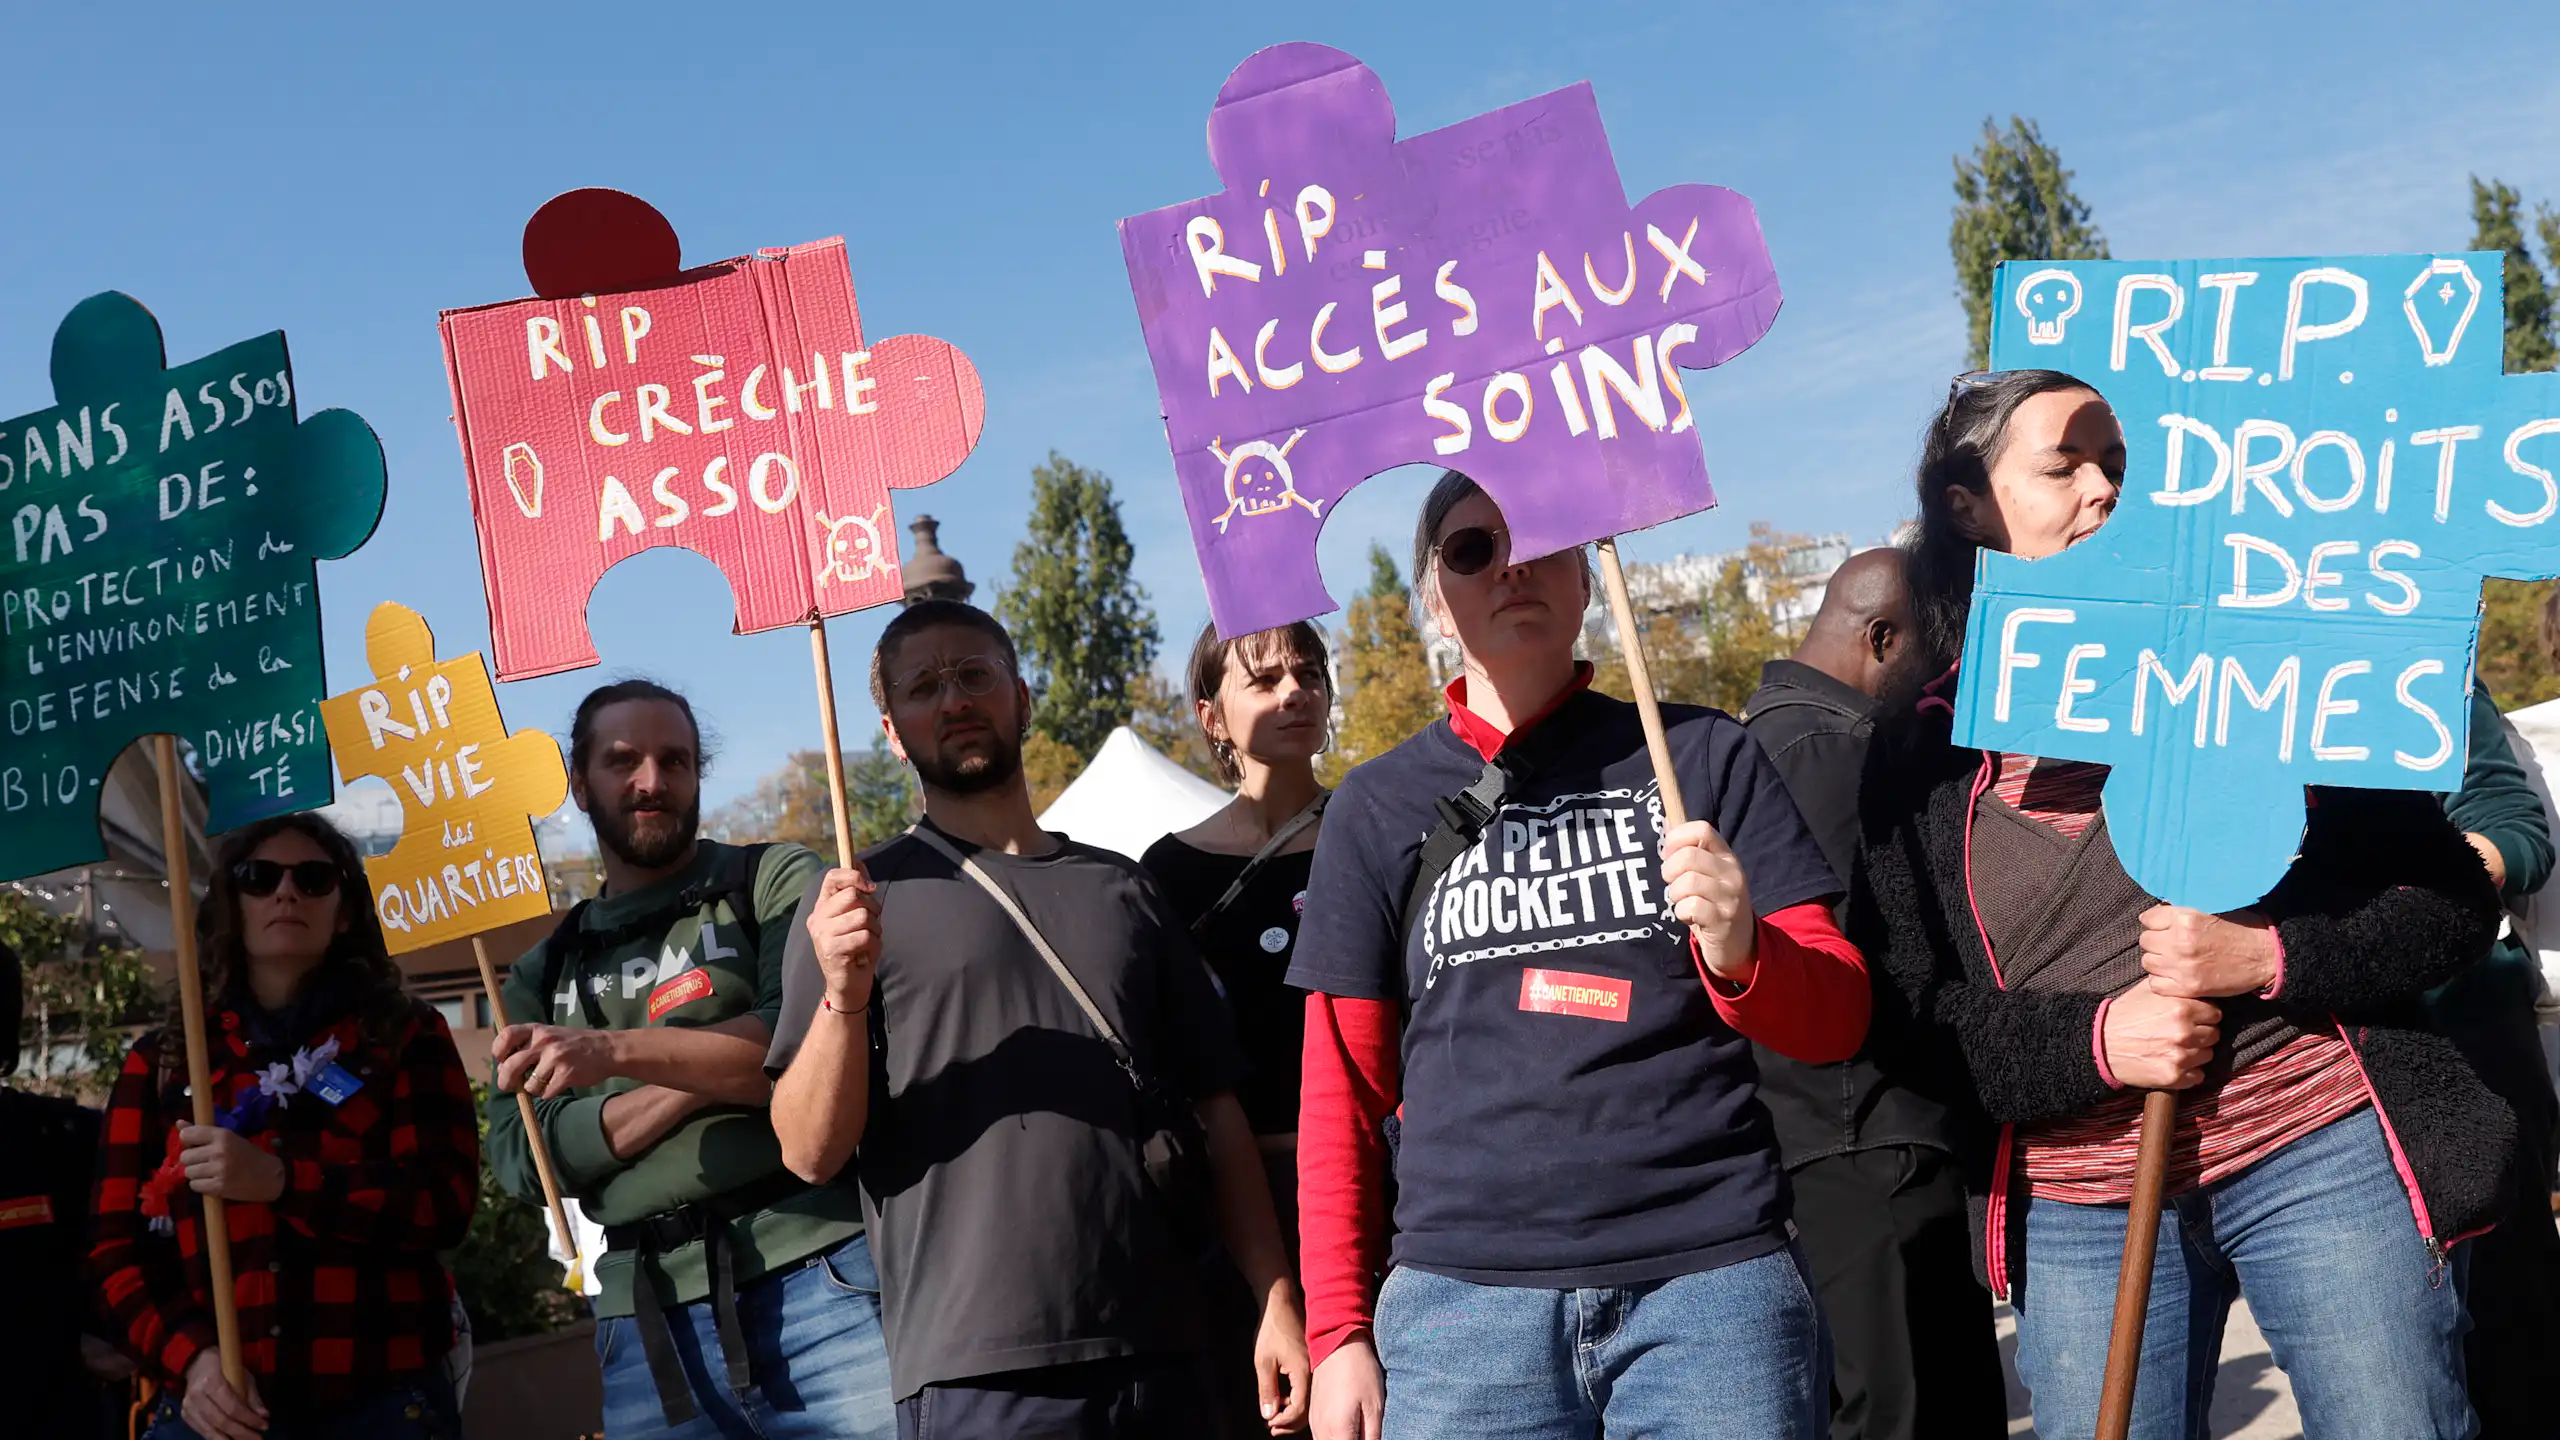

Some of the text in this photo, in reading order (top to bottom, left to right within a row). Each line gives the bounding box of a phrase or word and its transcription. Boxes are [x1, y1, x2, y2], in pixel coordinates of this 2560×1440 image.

[1206, 215, 1709, 398] ACCÈS AUX
[2110, 266, 2370, 387] R.I.P.
[588, 350, 878, 447] CRÈCHE
[11, 493, 108, 565] PAS
[598, 451, 801, 543] ASSO
[2216, 532, 2422, 617] DES
[9, 666, 186, 736] DEFENSE
[258, 645, 293, 674] la
[1993, 606, 2454, 772] FEMMES
[249, 752, 295, 799] TÉ
[441, 818, 475, 849] des
[1447, 808, 1645, 887] LA PETITE
[1440, 856, 1658, 945] ROCKETTE
